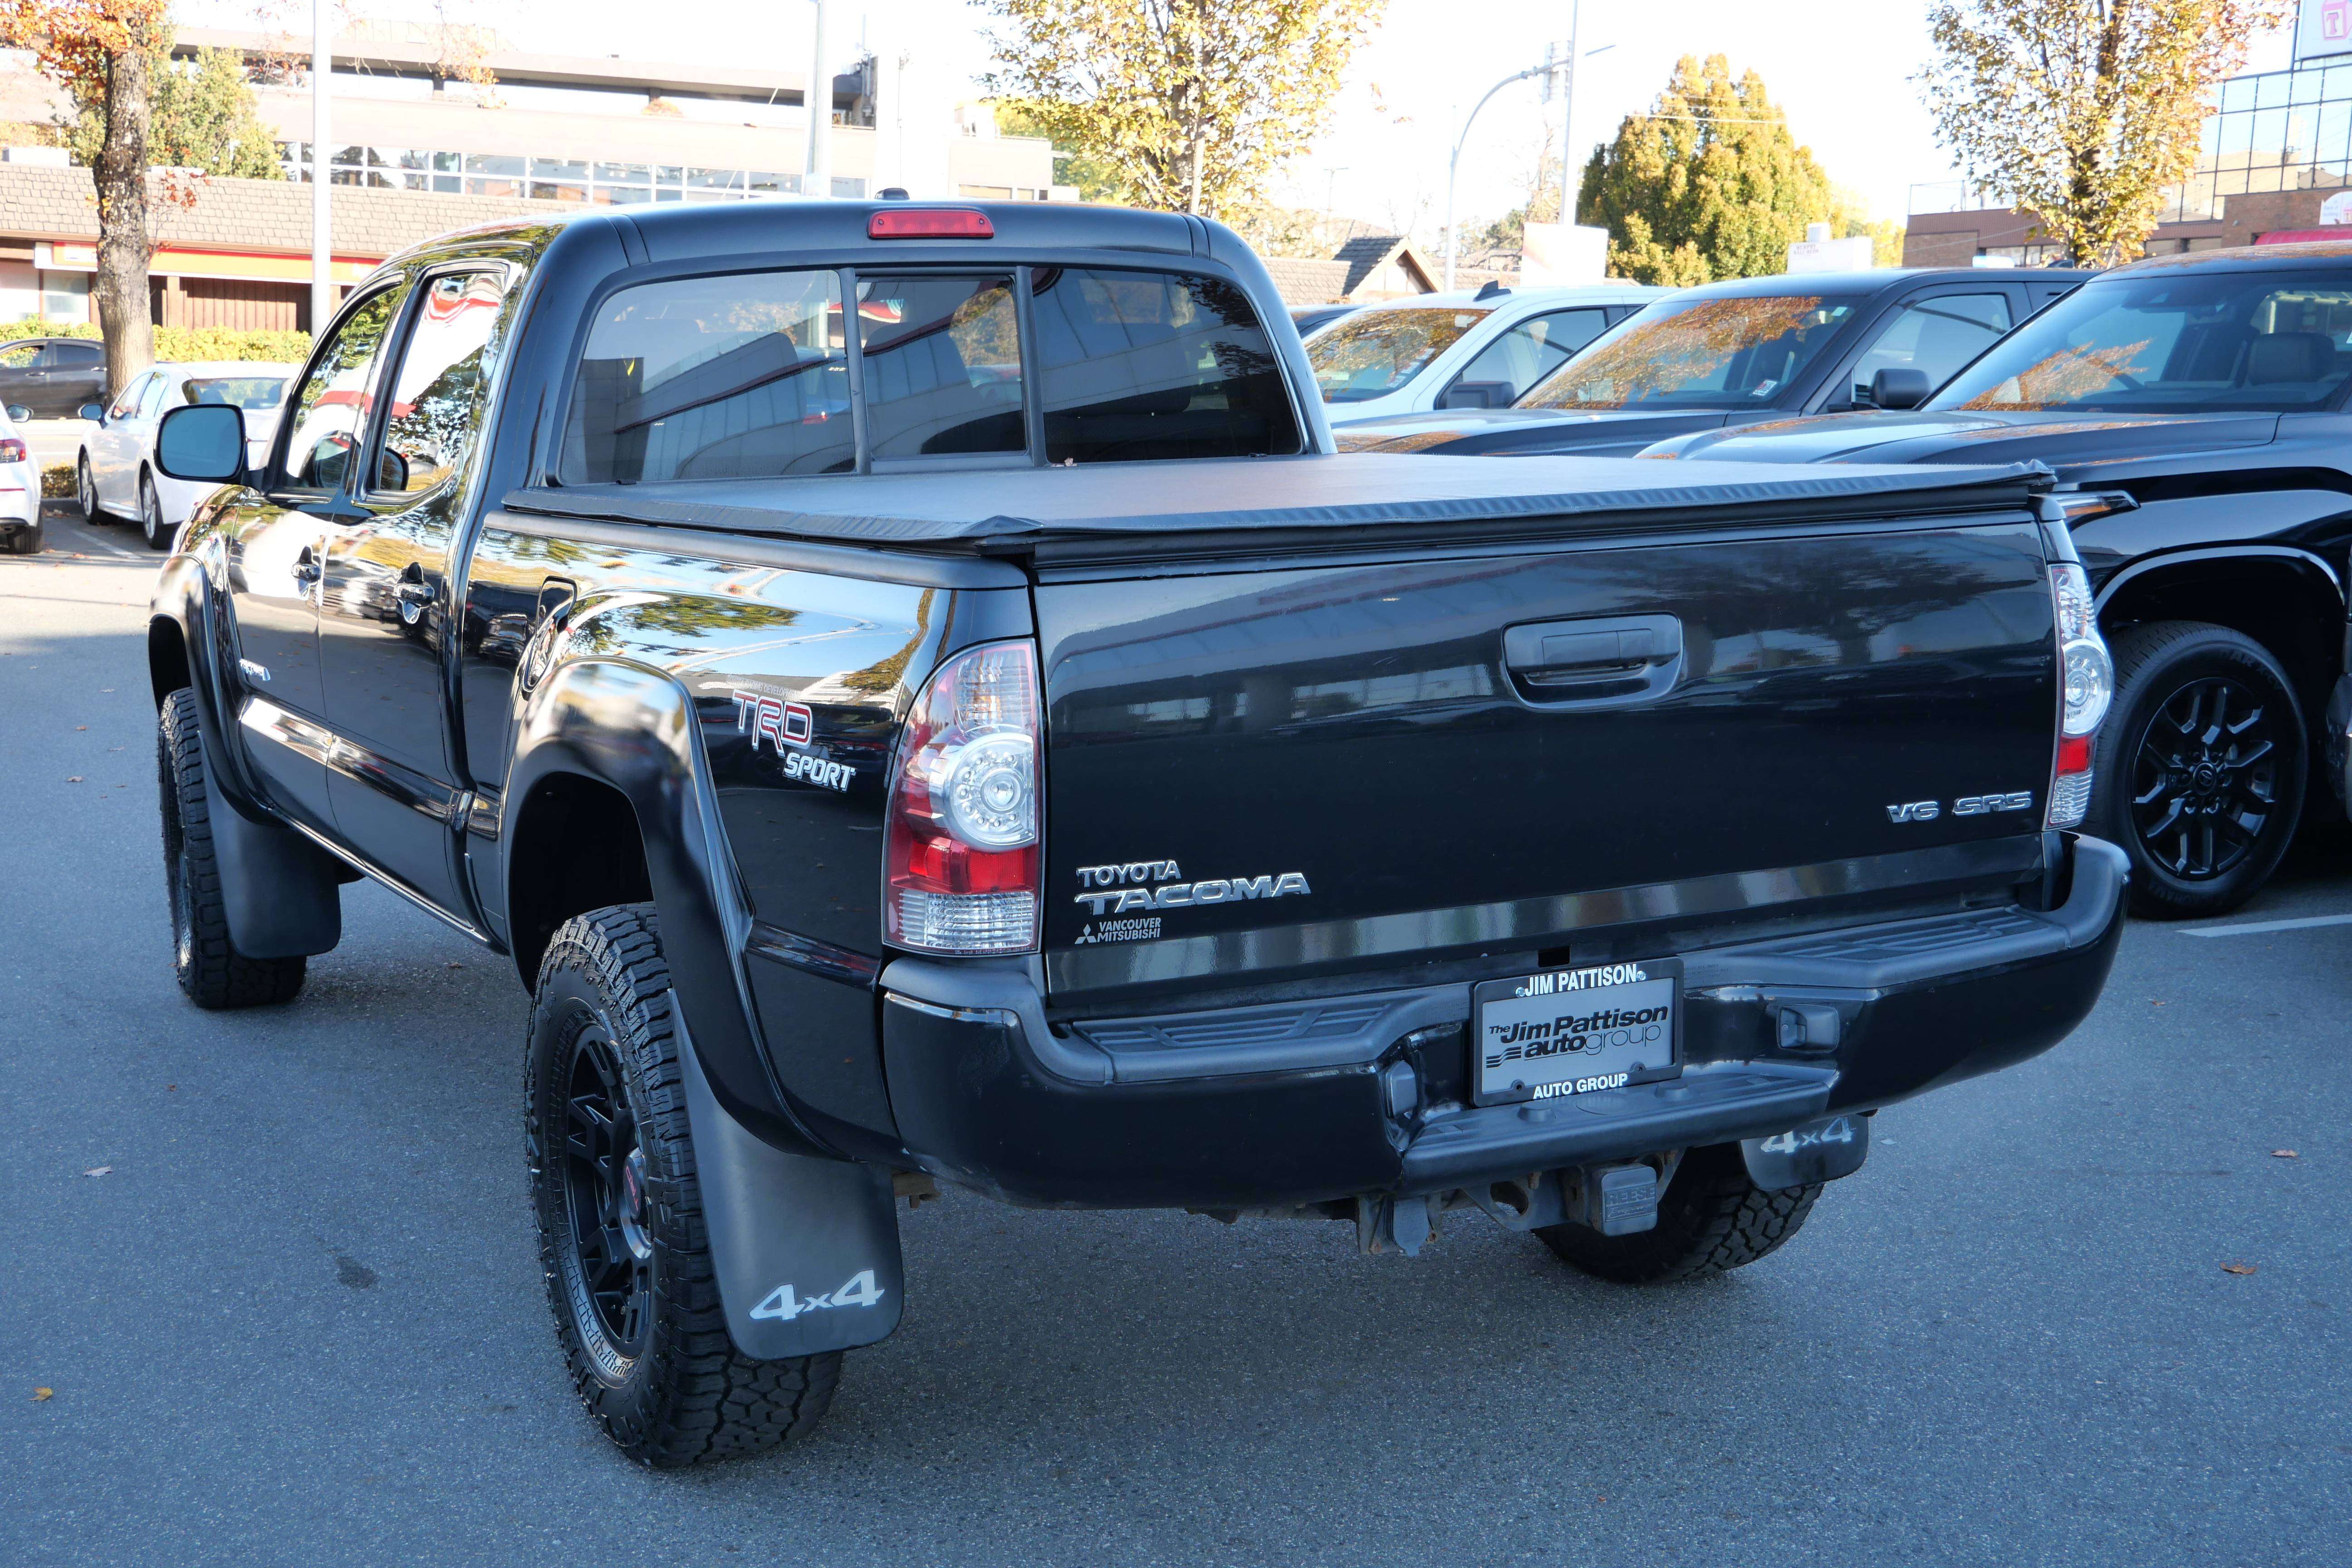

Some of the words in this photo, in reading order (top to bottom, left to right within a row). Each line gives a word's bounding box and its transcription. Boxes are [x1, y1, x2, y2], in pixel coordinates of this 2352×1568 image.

[732, 689, 813, 758] TRD
[784, 752, 858, 792] SPORT
[1886, 801, 1939, 823] V6
[1951, 791, 2032, 816] SR5
[1076, 859, 1181, 887] TOYOTA
[1073, 872, 1312, 916] TACOMA
[1097, 928, 1160, 942] MITSUBISHI
[1099, 917, 1161, 931] VANCOUVER
[1525, 974, 1553, 997] JIM
[1558, 963, 1637, 993] PATTISON
[1489, 1024, 1511, 1035] The
[1533, 1081, 1573, 1100] AUTO
[1576, 1073, 1628, 1093] GROUP
[1760, 1115, 1857, 1154] 4x4
[1605, 1185, 1655, 1206] REESE
[748, 1269, 885, 1321] 4x4
